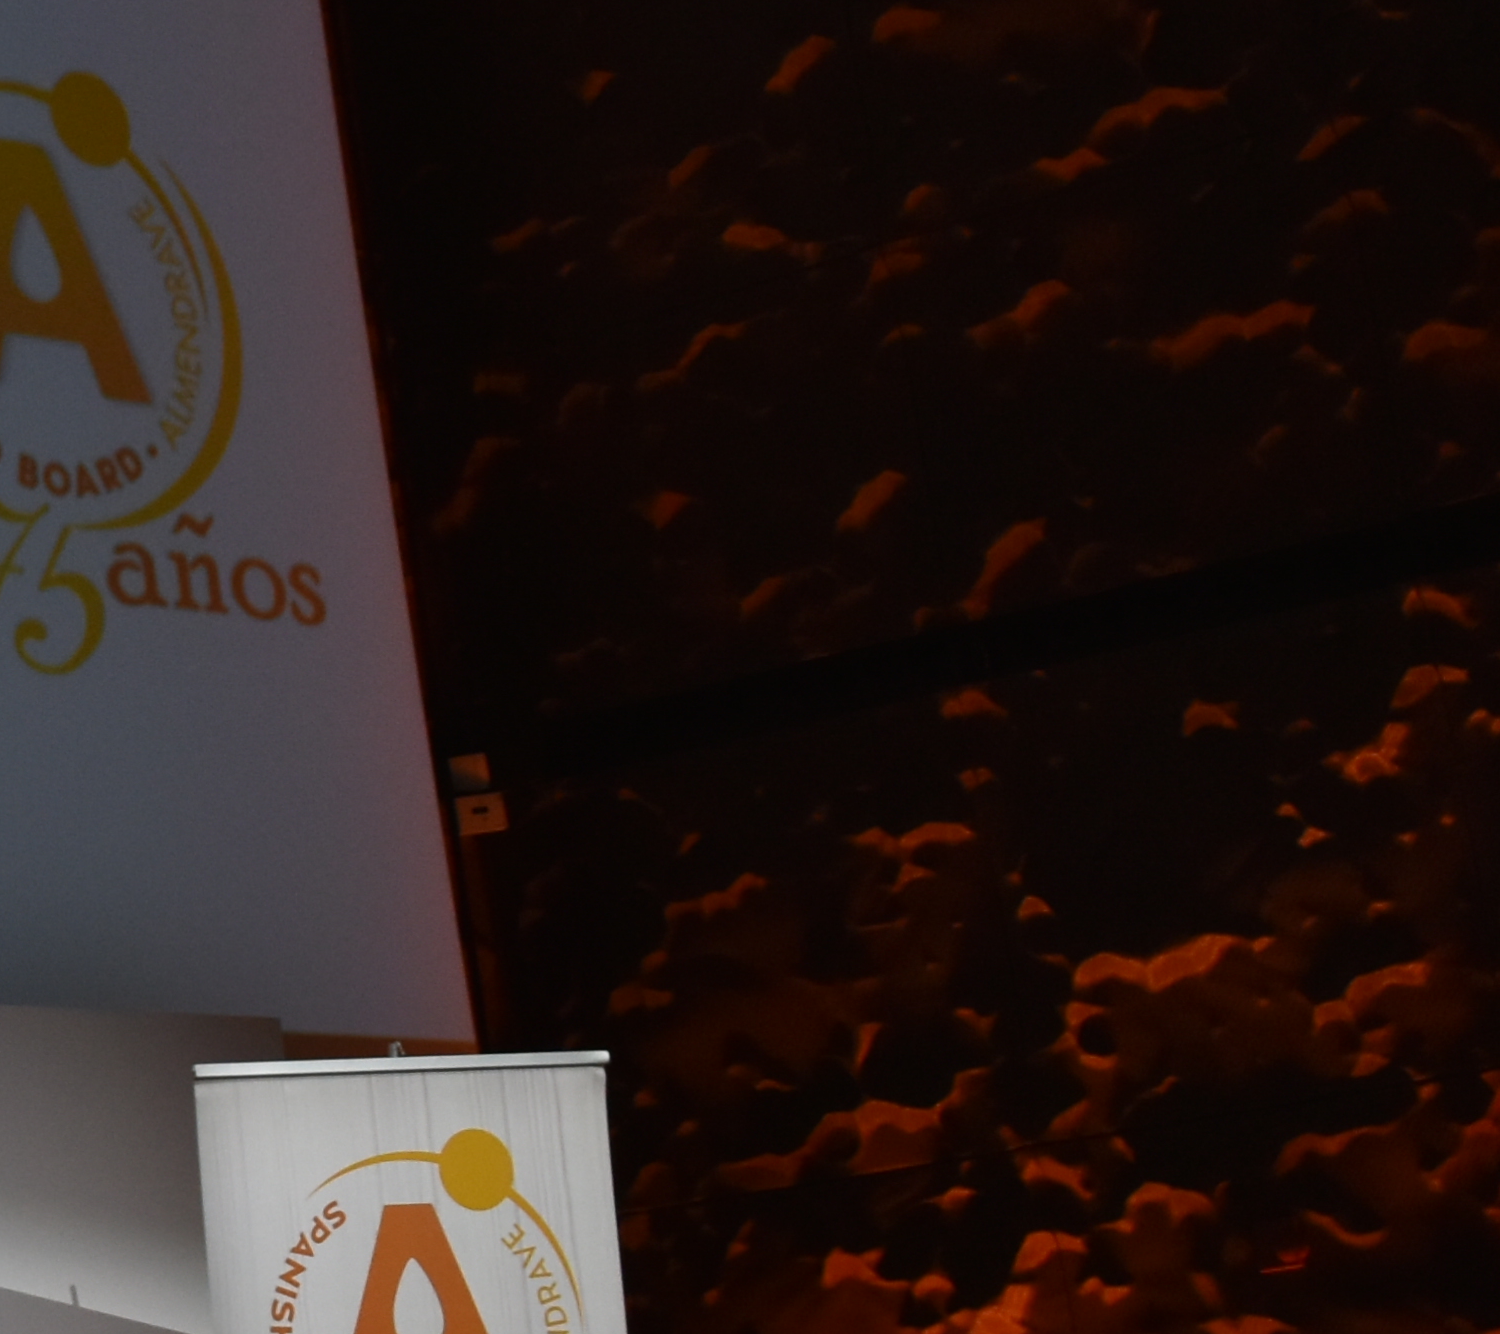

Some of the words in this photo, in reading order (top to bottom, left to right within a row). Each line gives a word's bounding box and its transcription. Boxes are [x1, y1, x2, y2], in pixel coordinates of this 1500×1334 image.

[129, 194, 201, 452] ALMENDRAVE
[18, 445, 145, 499] BOARD
[106, 512, 327, 626] años
